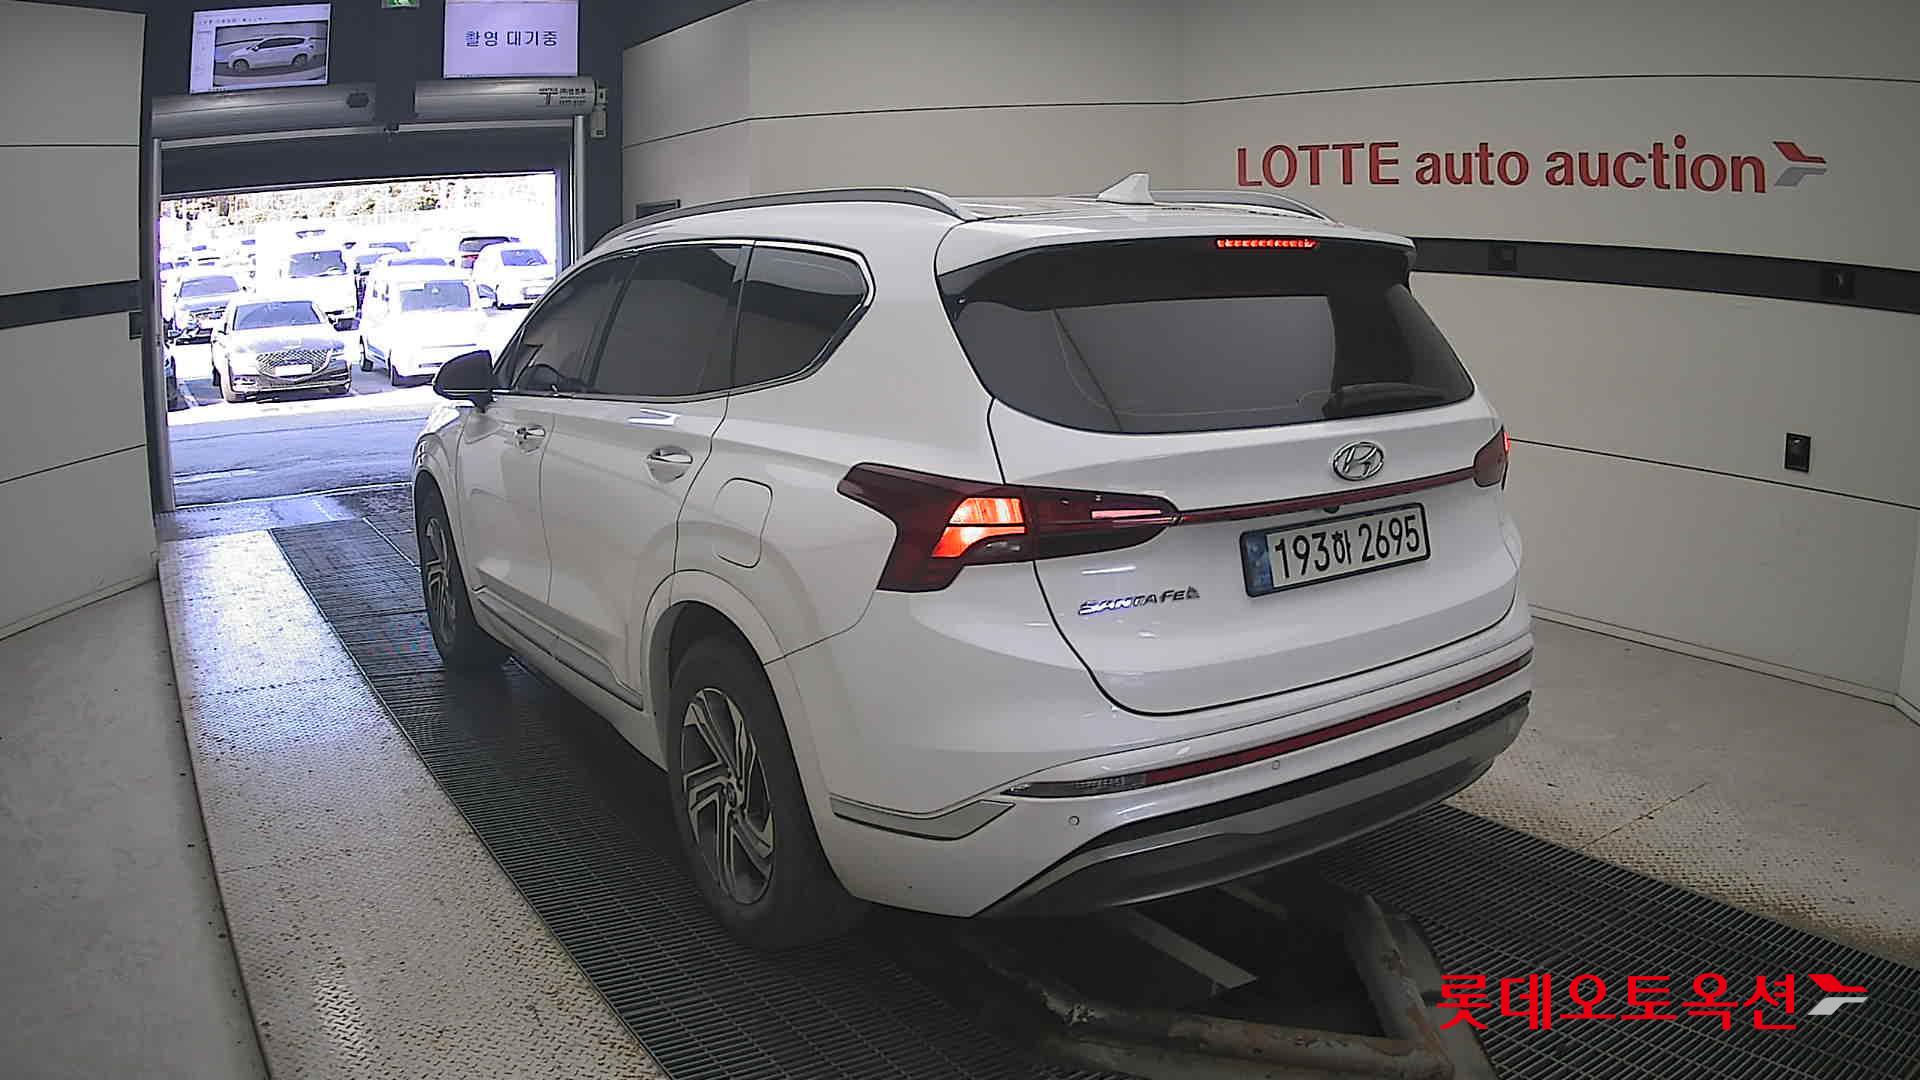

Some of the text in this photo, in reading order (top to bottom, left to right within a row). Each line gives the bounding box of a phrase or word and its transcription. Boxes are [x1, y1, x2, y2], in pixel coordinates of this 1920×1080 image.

[506, 30, 558, 47] 대기중
[1237, 134, 1767, 193] LOTTE auto auction
[1274, 514, 1420, 578] 193하 2695
